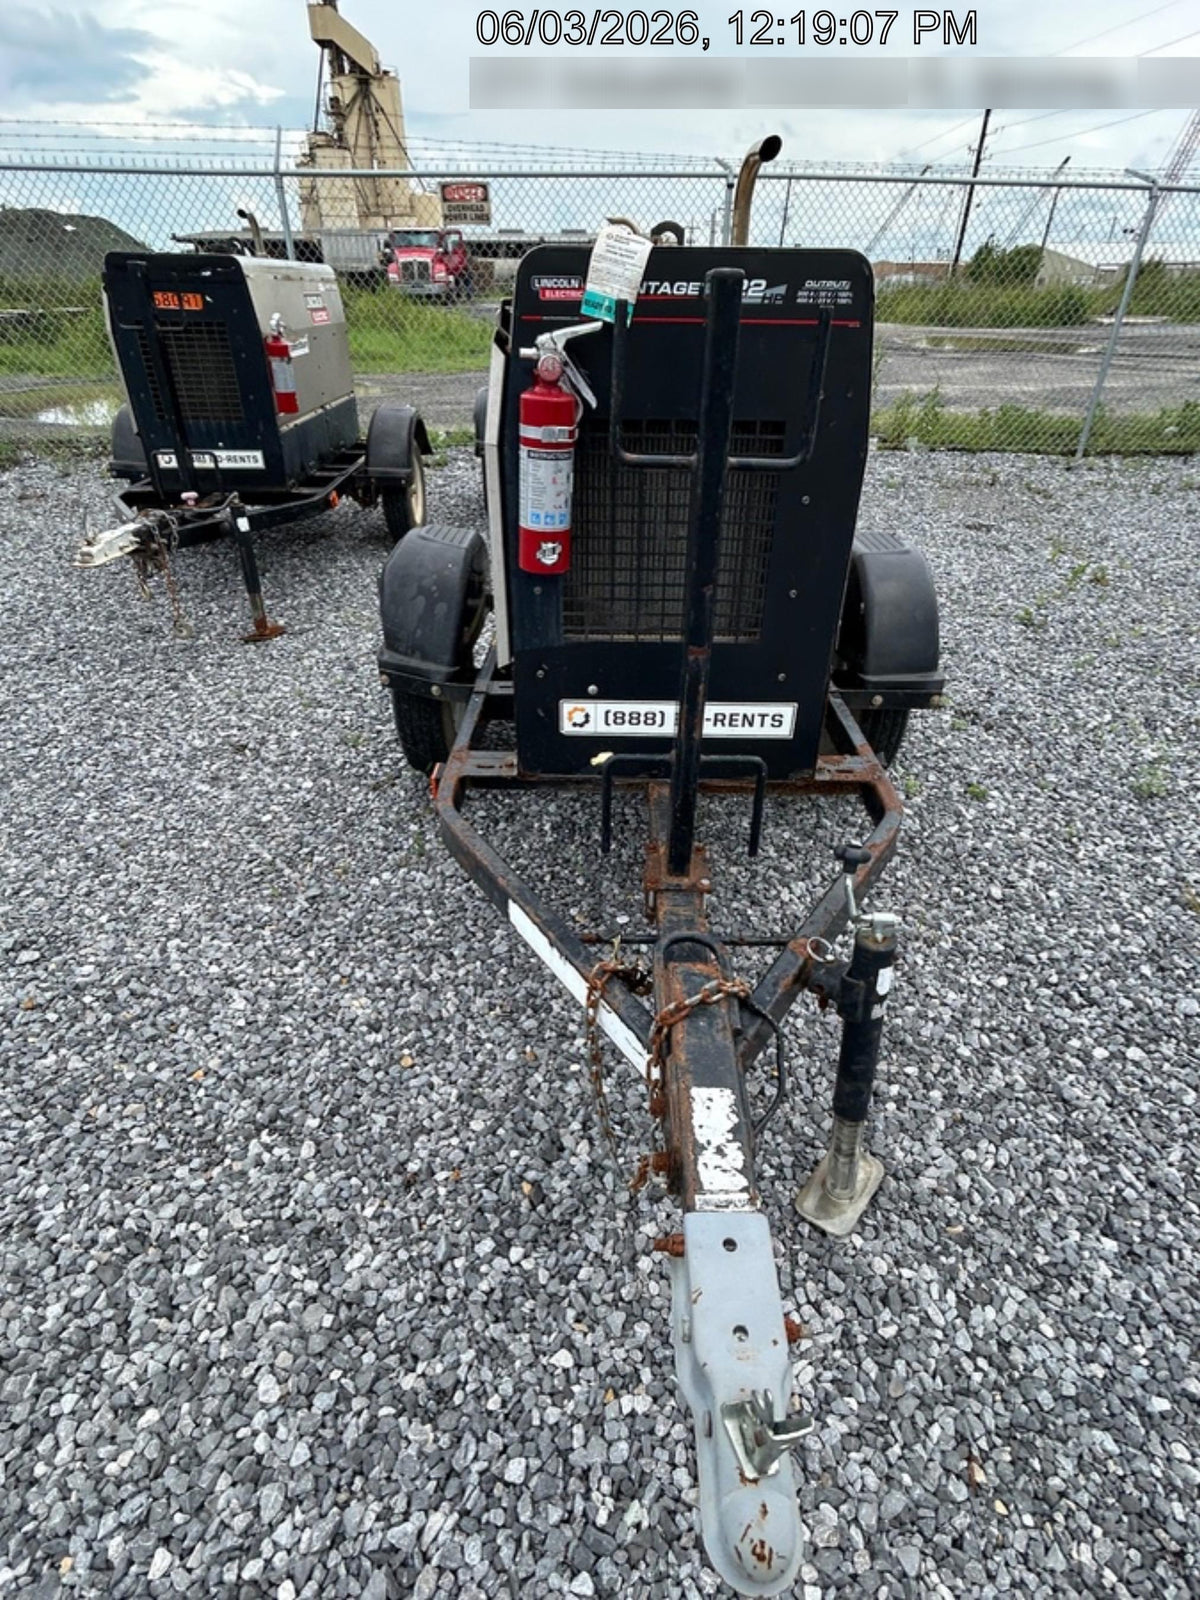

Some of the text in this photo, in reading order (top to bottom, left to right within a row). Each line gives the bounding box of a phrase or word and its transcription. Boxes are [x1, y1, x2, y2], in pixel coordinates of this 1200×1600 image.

[534, 278, 580, 288] LINCOLN
[604, 710, 784, 728] (888) -RENTS
